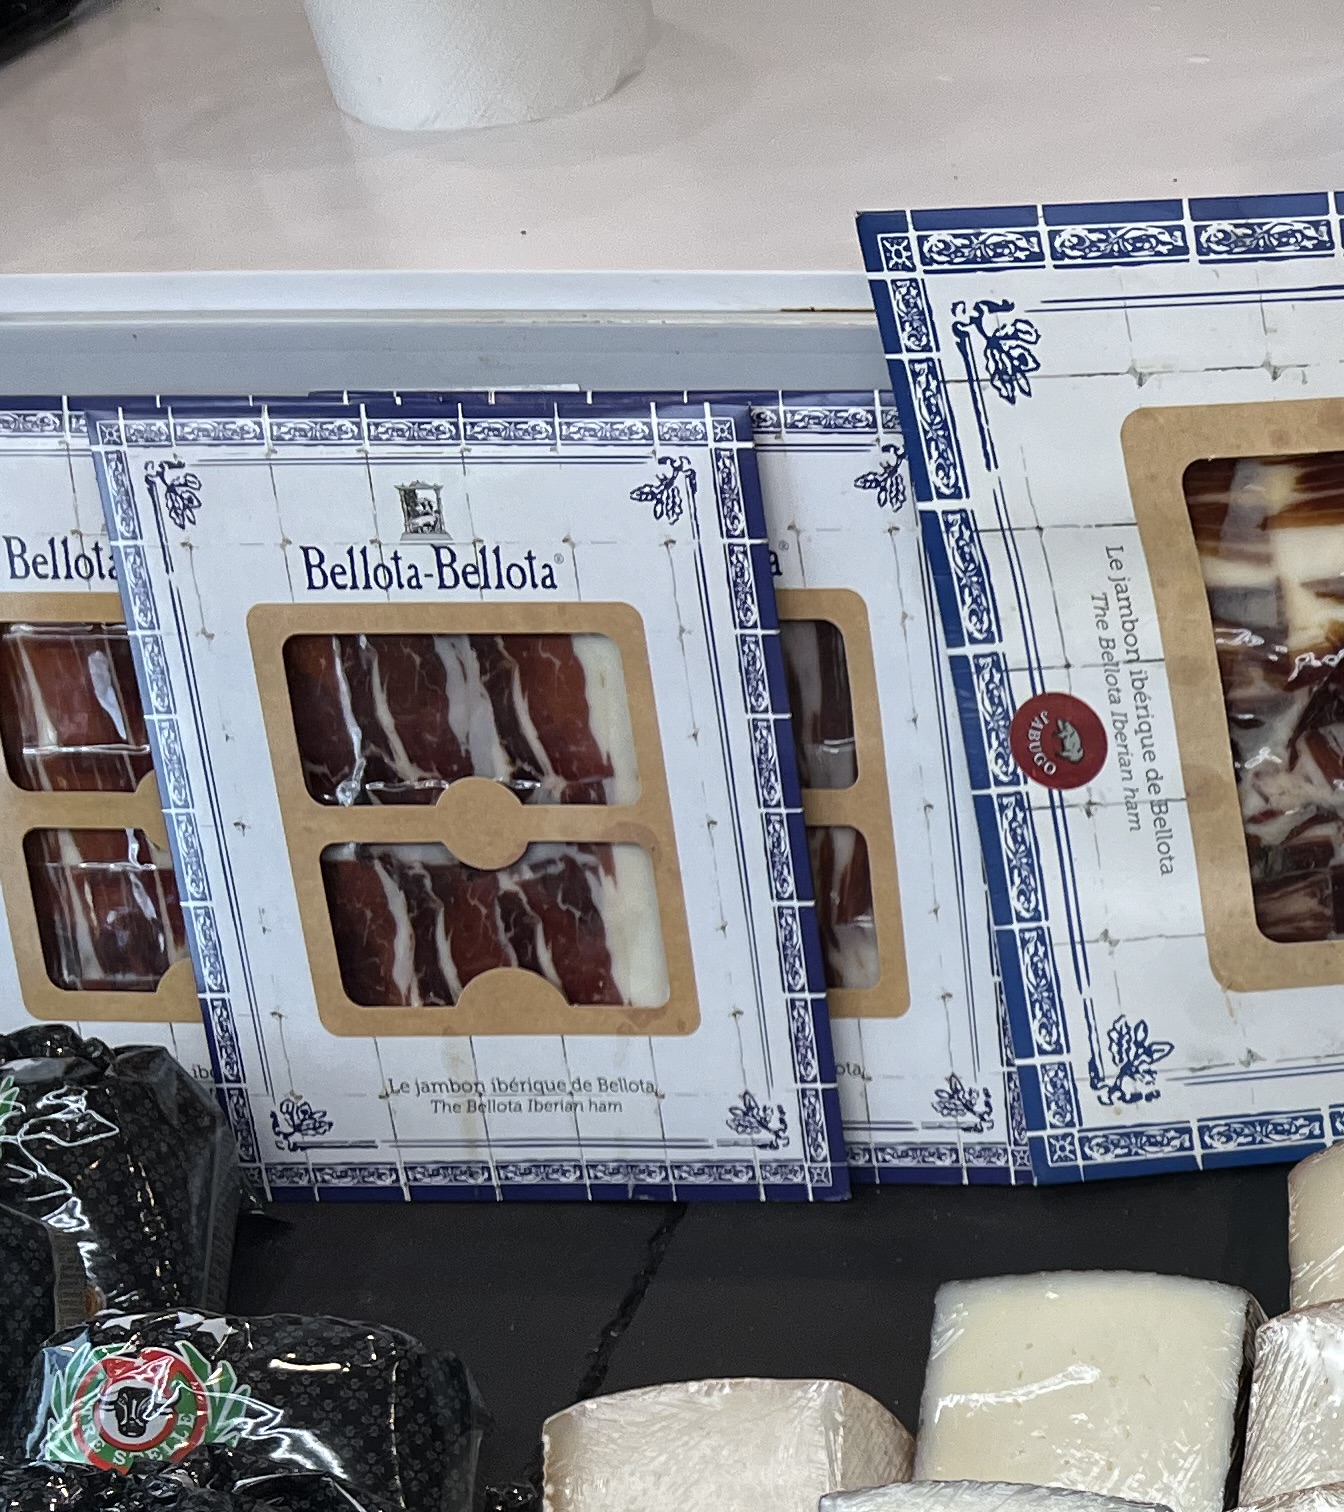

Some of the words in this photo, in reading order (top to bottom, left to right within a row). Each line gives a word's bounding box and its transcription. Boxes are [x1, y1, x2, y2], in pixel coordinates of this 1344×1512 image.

[300, 544, 558, 590] Bellota-Bellota
[1105, 545, 1124, 571] Le
[1091, 592, 1109, 631] The
[1108, 575, 1141, 664] jambon
[1098, 637, 1121, 704] Bellota
[1128, 668, 1156, 762] ibérique
[1027, 709, 1057, 776] JABUGO
[1110, 708, 1133, 783] Iberian
[1143, 768, 1161, 796] de
[1124, 786, 1141, 831] ham
[1150, 798, 1175, 876] Bellota
[387, 1077, 410, 1094] Le
[415, 1077, 485, 1098] jambon
[491, 1076, 567, 1097] ibérique
[571, 1077, 592, 1094] de
[597, 1076, 656, 1094] Bellota
[431, 1099, 462, 1114] The
[466, 1099, 523, 1114] Bellota
[528, 1099, 584, 1114] Iberian
[588, 1099, 623, 1114] ham
